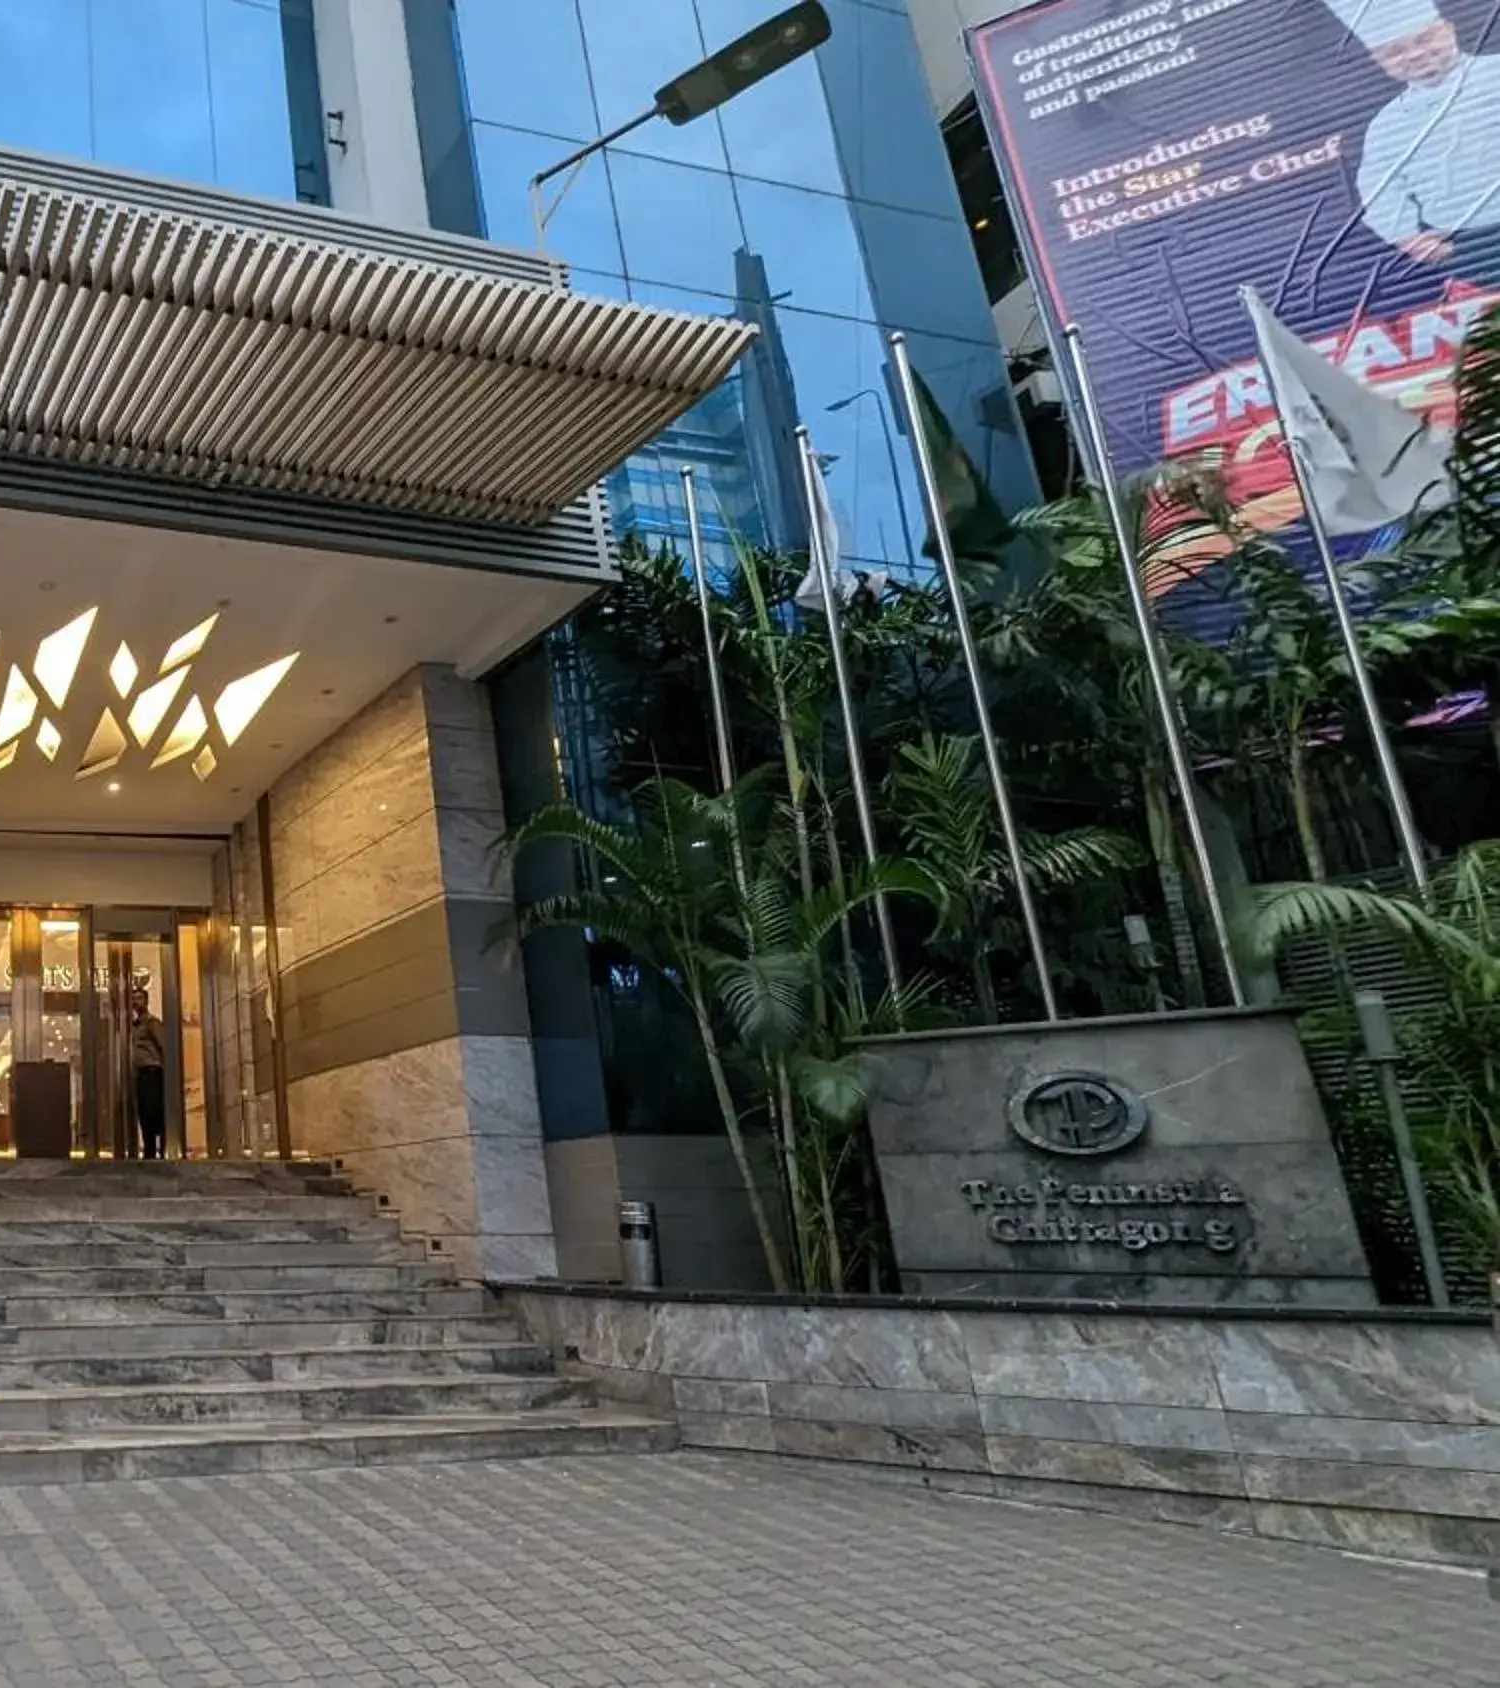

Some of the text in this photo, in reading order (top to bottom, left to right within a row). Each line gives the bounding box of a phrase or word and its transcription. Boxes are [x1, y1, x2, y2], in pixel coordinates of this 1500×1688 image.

[1011, 0, 1175, 67] Gastronomy
[1023, 32, 1184, 102] authenticity
[1017, 62, 1048, 85] of
[1028, 46, 1198, 121] and passion!
[1051, 112, 1272, 198] Introducing
[1066, 133, 1342, 242] Executive Chef
[1059, 160, 1201, 219] the Star
[960, 1179, 1037, 1207] The
